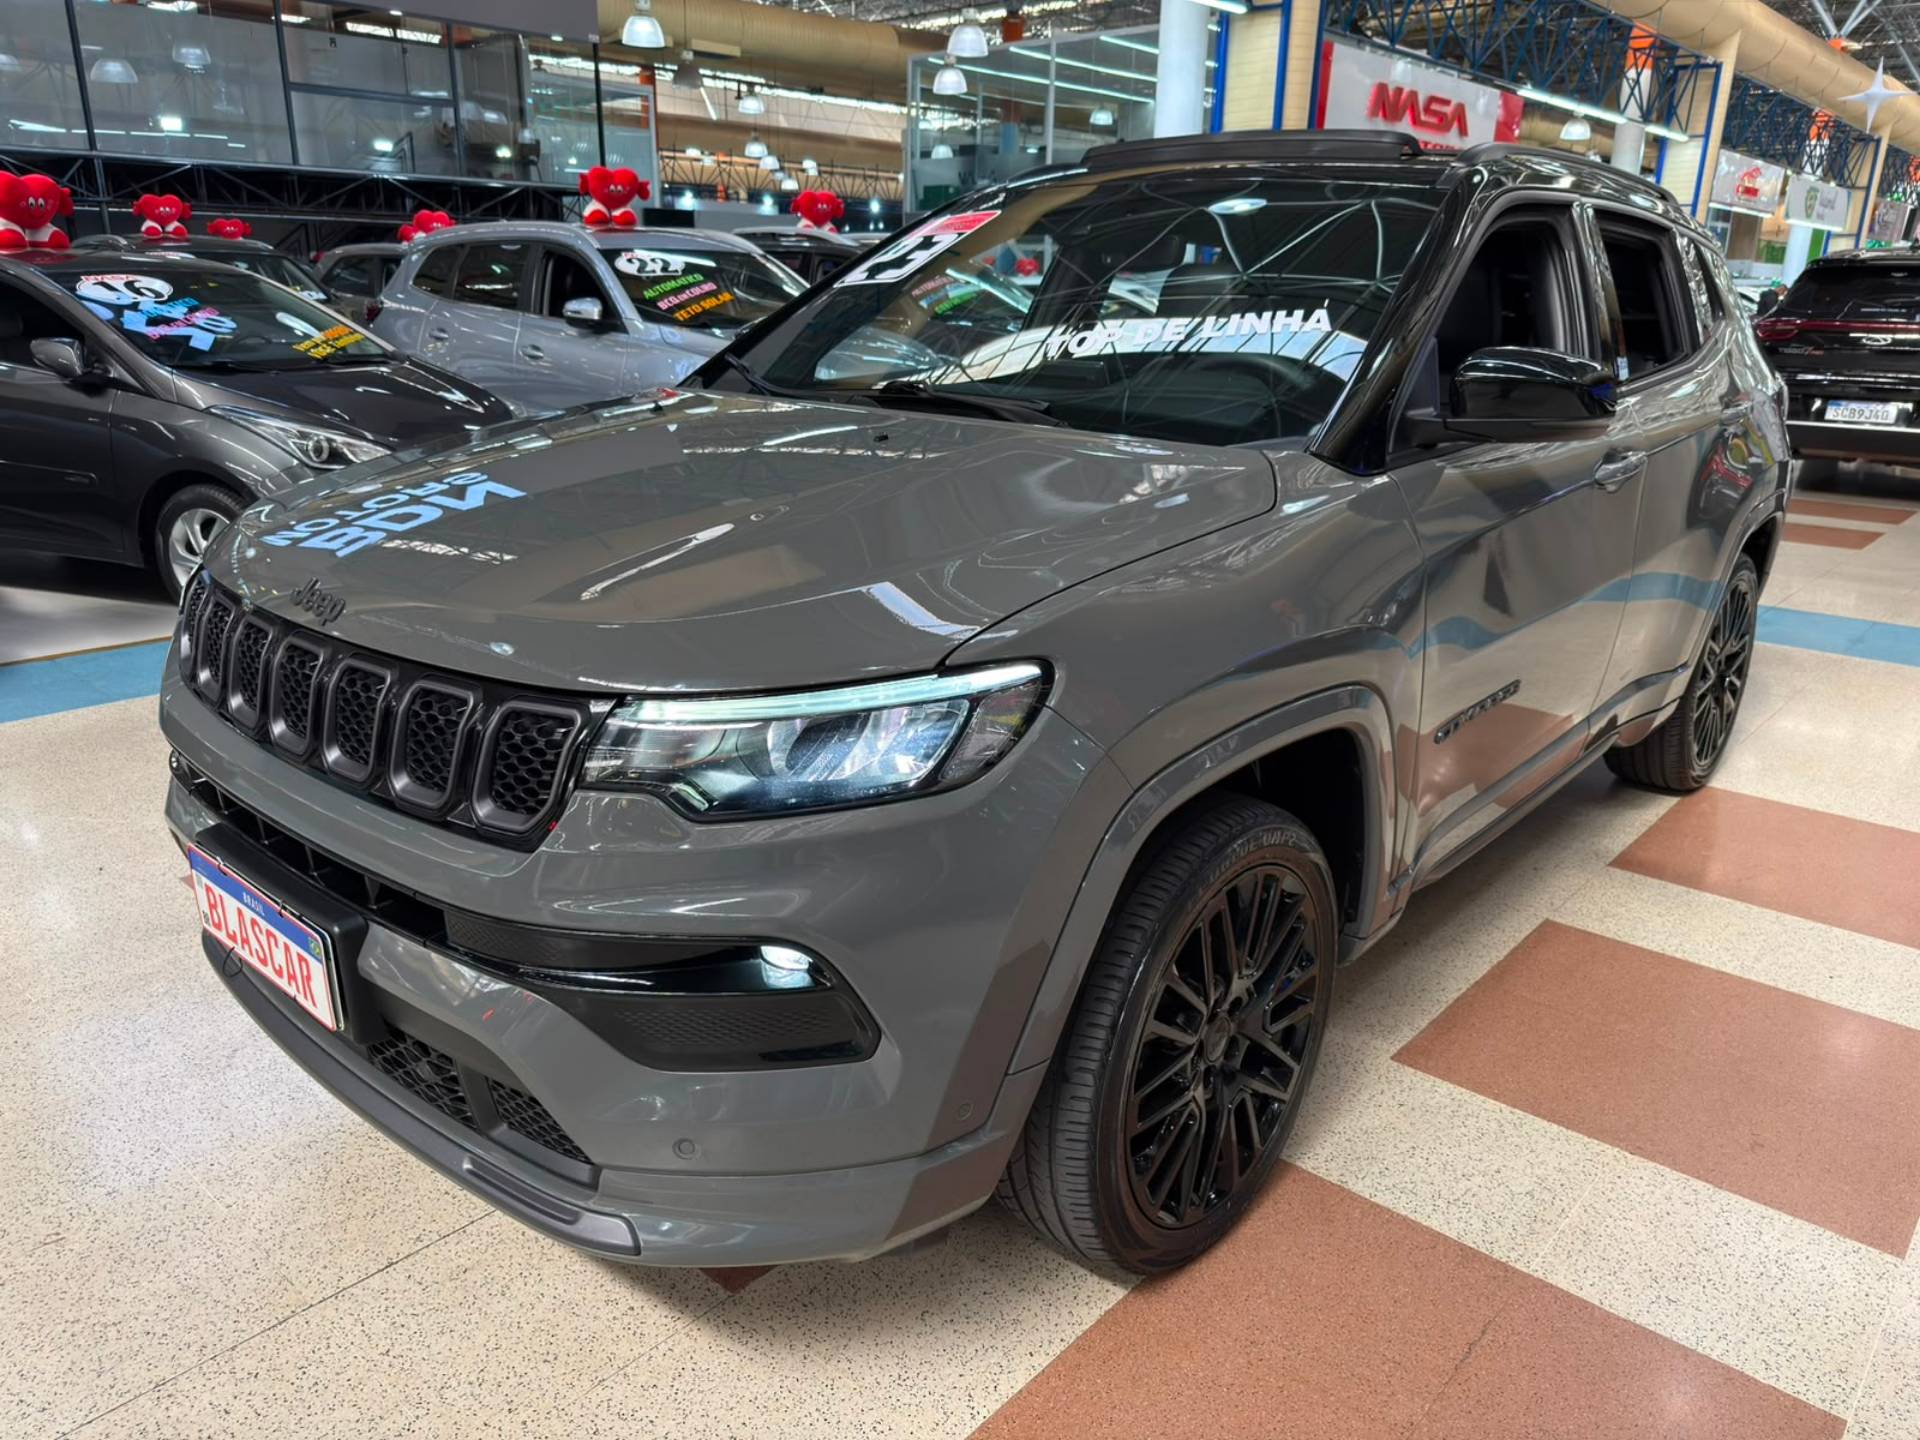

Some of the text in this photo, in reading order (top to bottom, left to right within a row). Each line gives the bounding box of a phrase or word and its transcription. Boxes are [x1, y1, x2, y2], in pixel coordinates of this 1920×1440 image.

[1368, 82, 1469, 138] NASA
[626, 257, 681, 274] 22
[92, 279, 165, 300] 16
[673, 303, 703, 322] TETO
[1047, 308, 1333, 355] TOP DE LINHA
[290, 577, 346, 626] Jeep
[243, 892, 265, 916] BRASIL
[204, 882, 318, 1009] BLASCAR
